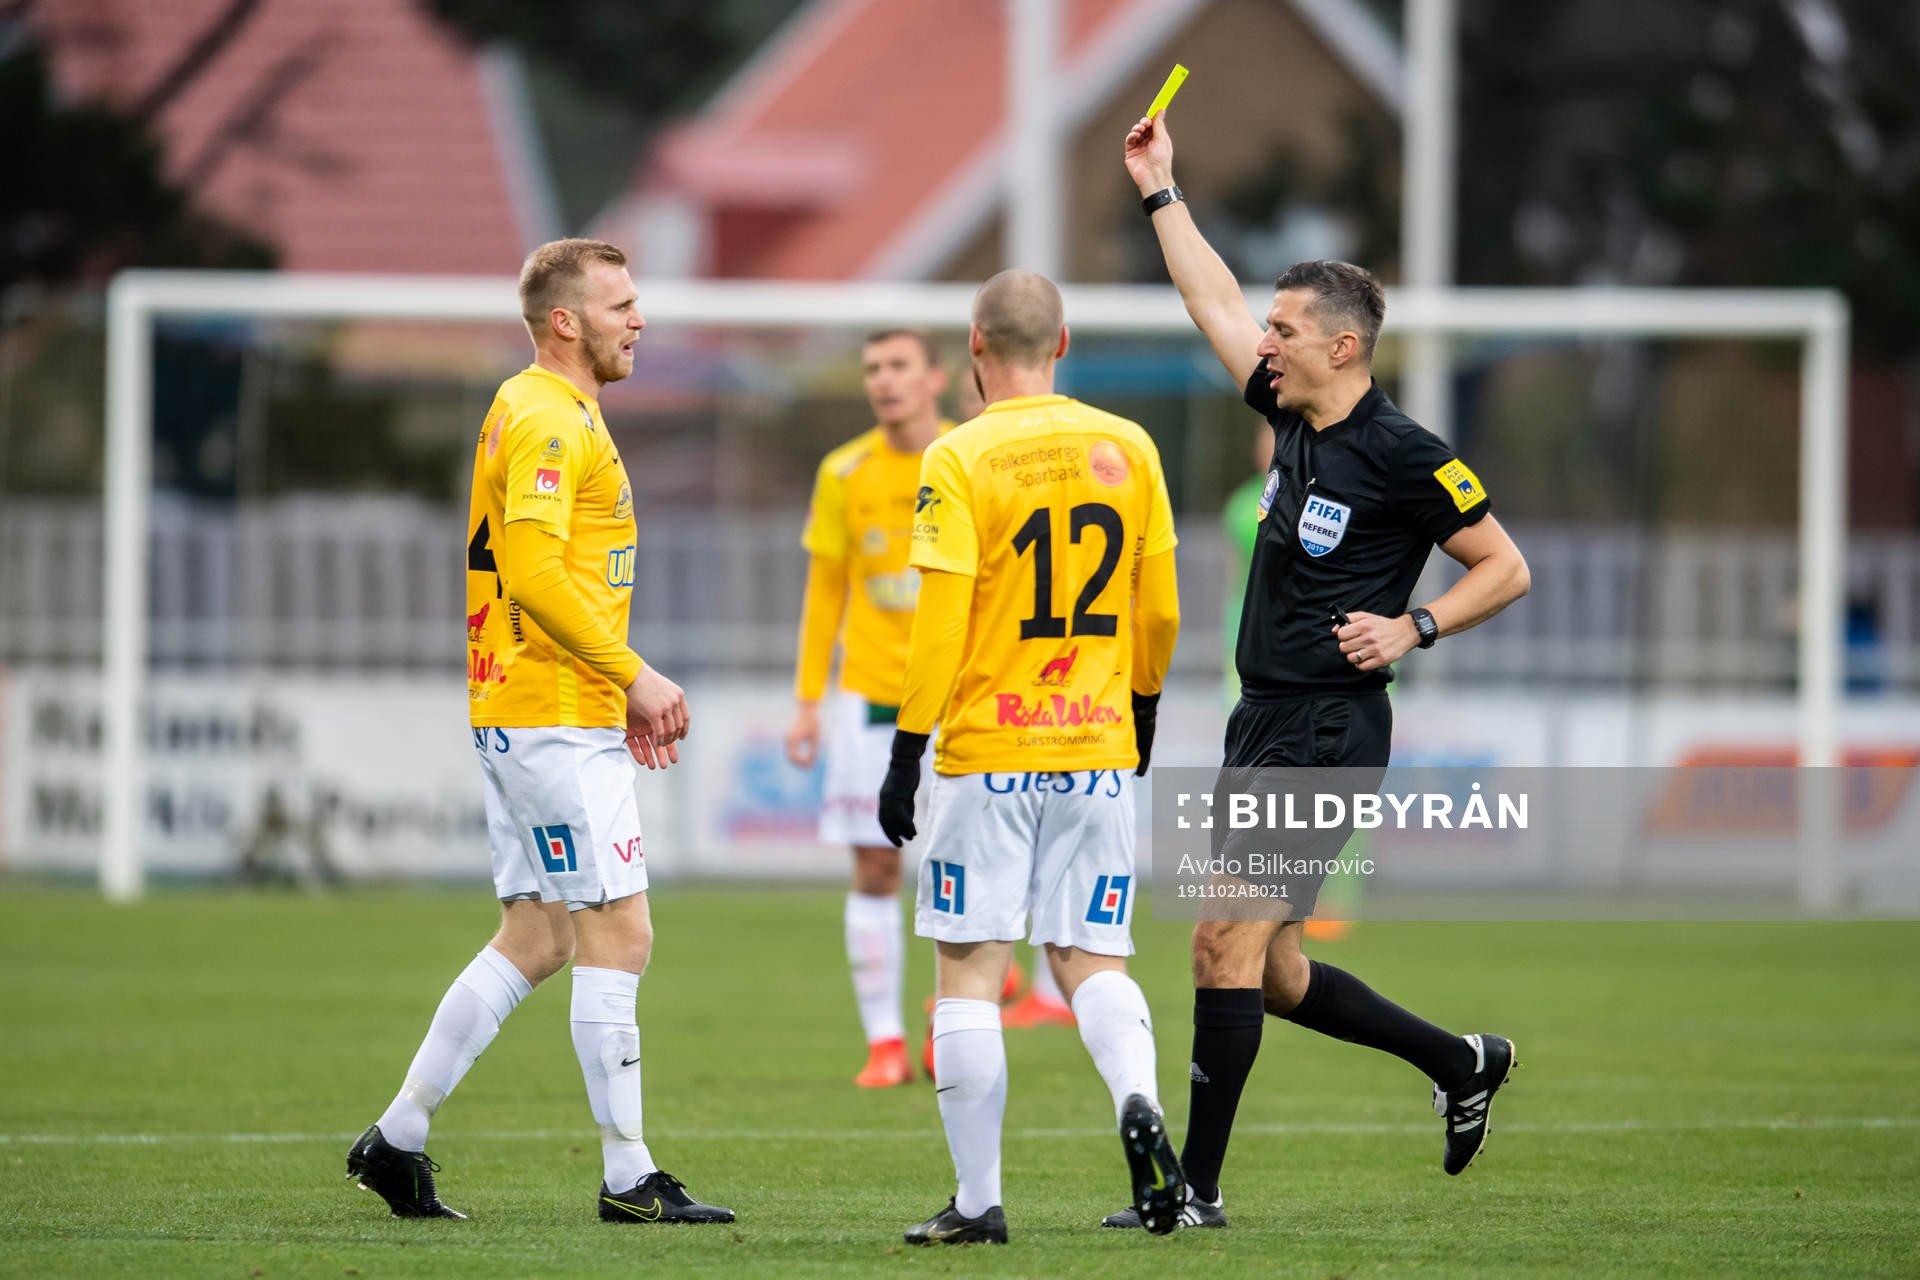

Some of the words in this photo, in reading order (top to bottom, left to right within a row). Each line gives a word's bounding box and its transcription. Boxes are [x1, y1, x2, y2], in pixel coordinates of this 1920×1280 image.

[990, 447, 1080, 473] Falkenbergs
[1015, 465, 1082, 490] Sparbank
[1307, 500, 1342, 523] FIFA
[1302, 521, 1338, 539] REFEREE
[1306, 542, 1324, 553] 2019
[1011, 502, 1124, 641] 12
